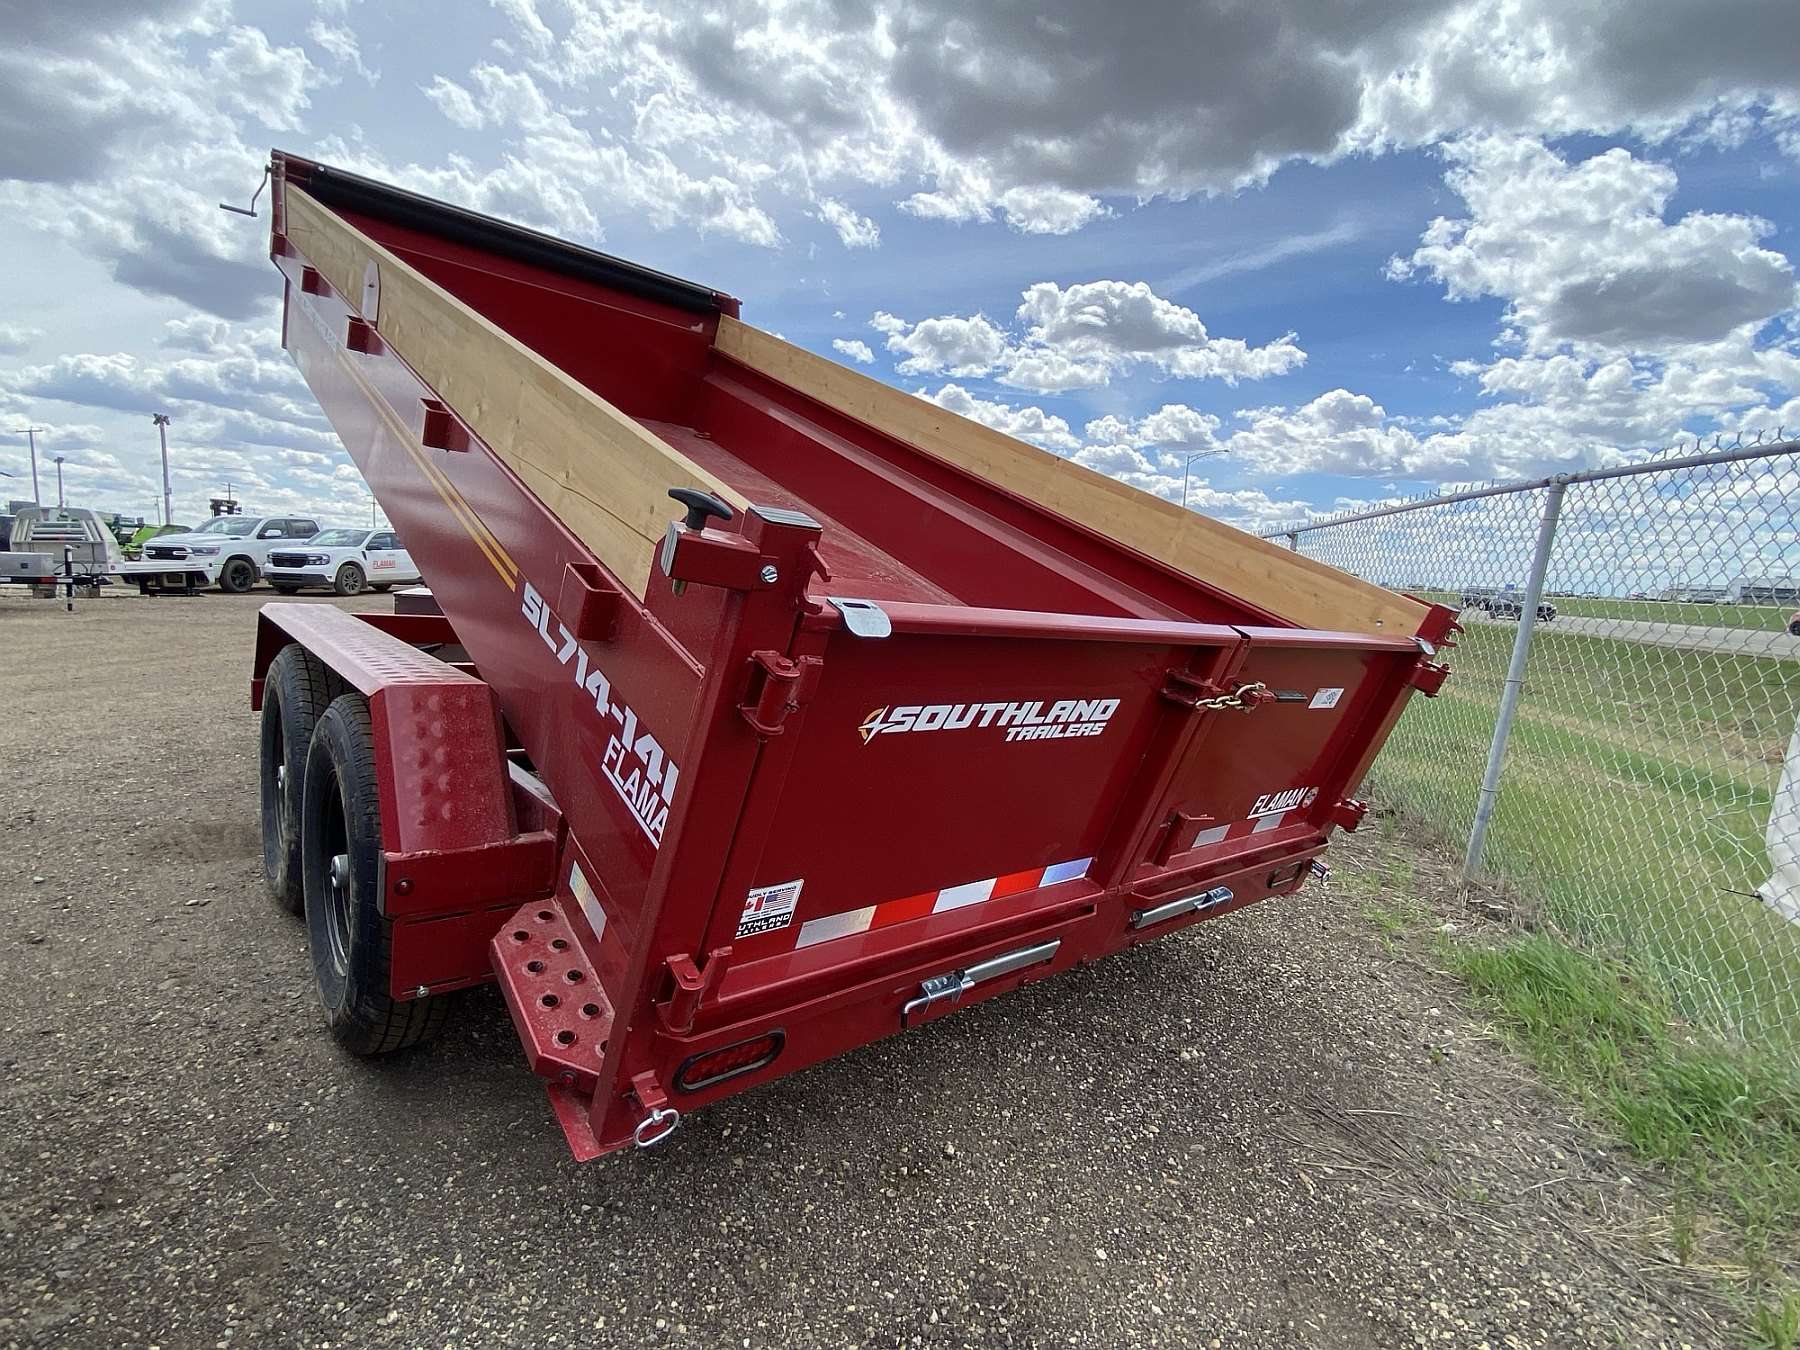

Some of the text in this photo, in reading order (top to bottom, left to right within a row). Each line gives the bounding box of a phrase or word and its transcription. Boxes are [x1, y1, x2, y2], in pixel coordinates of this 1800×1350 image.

[881, 698, 1121, 734] SOUTHLAND
[1005, 721, 1107, 742] TRAILERS
[603, 734, 670, 842] FLAMA
[1249, 786, 1309, 815] FLAMAN
[735, 922, 782, 937] RAILERS
[738, 913, 790, 931] UTHLAND
